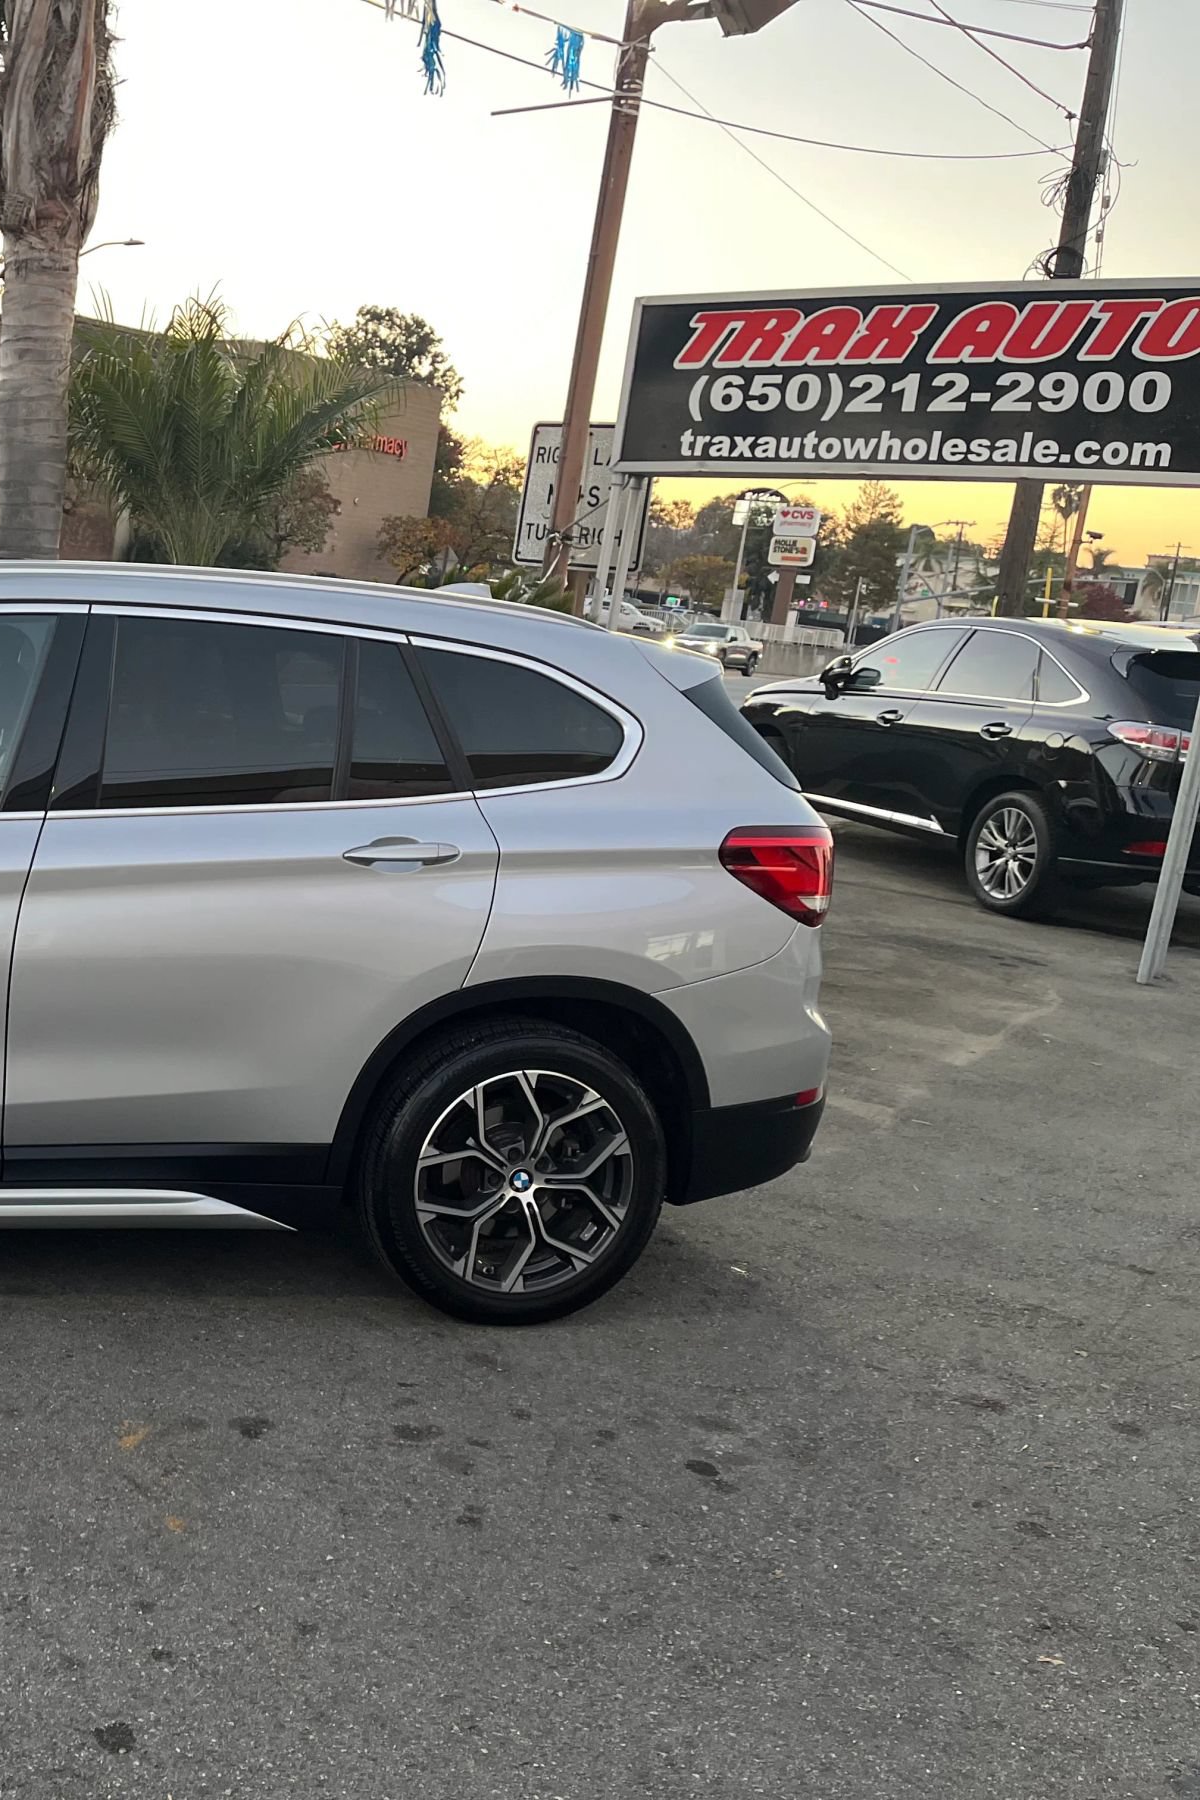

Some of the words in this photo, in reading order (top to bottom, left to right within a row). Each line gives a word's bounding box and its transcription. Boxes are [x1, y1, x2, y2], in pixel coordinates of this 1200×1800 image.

[673, 304, 939, 370] TRAX
[925, 296, 1200, 365] AUTO
[688, 371, 1172, 422] (650)212-2900
[680, 428, 1172, 467] traxautowholesale.com
[791, 510, 814, 520] CVS
